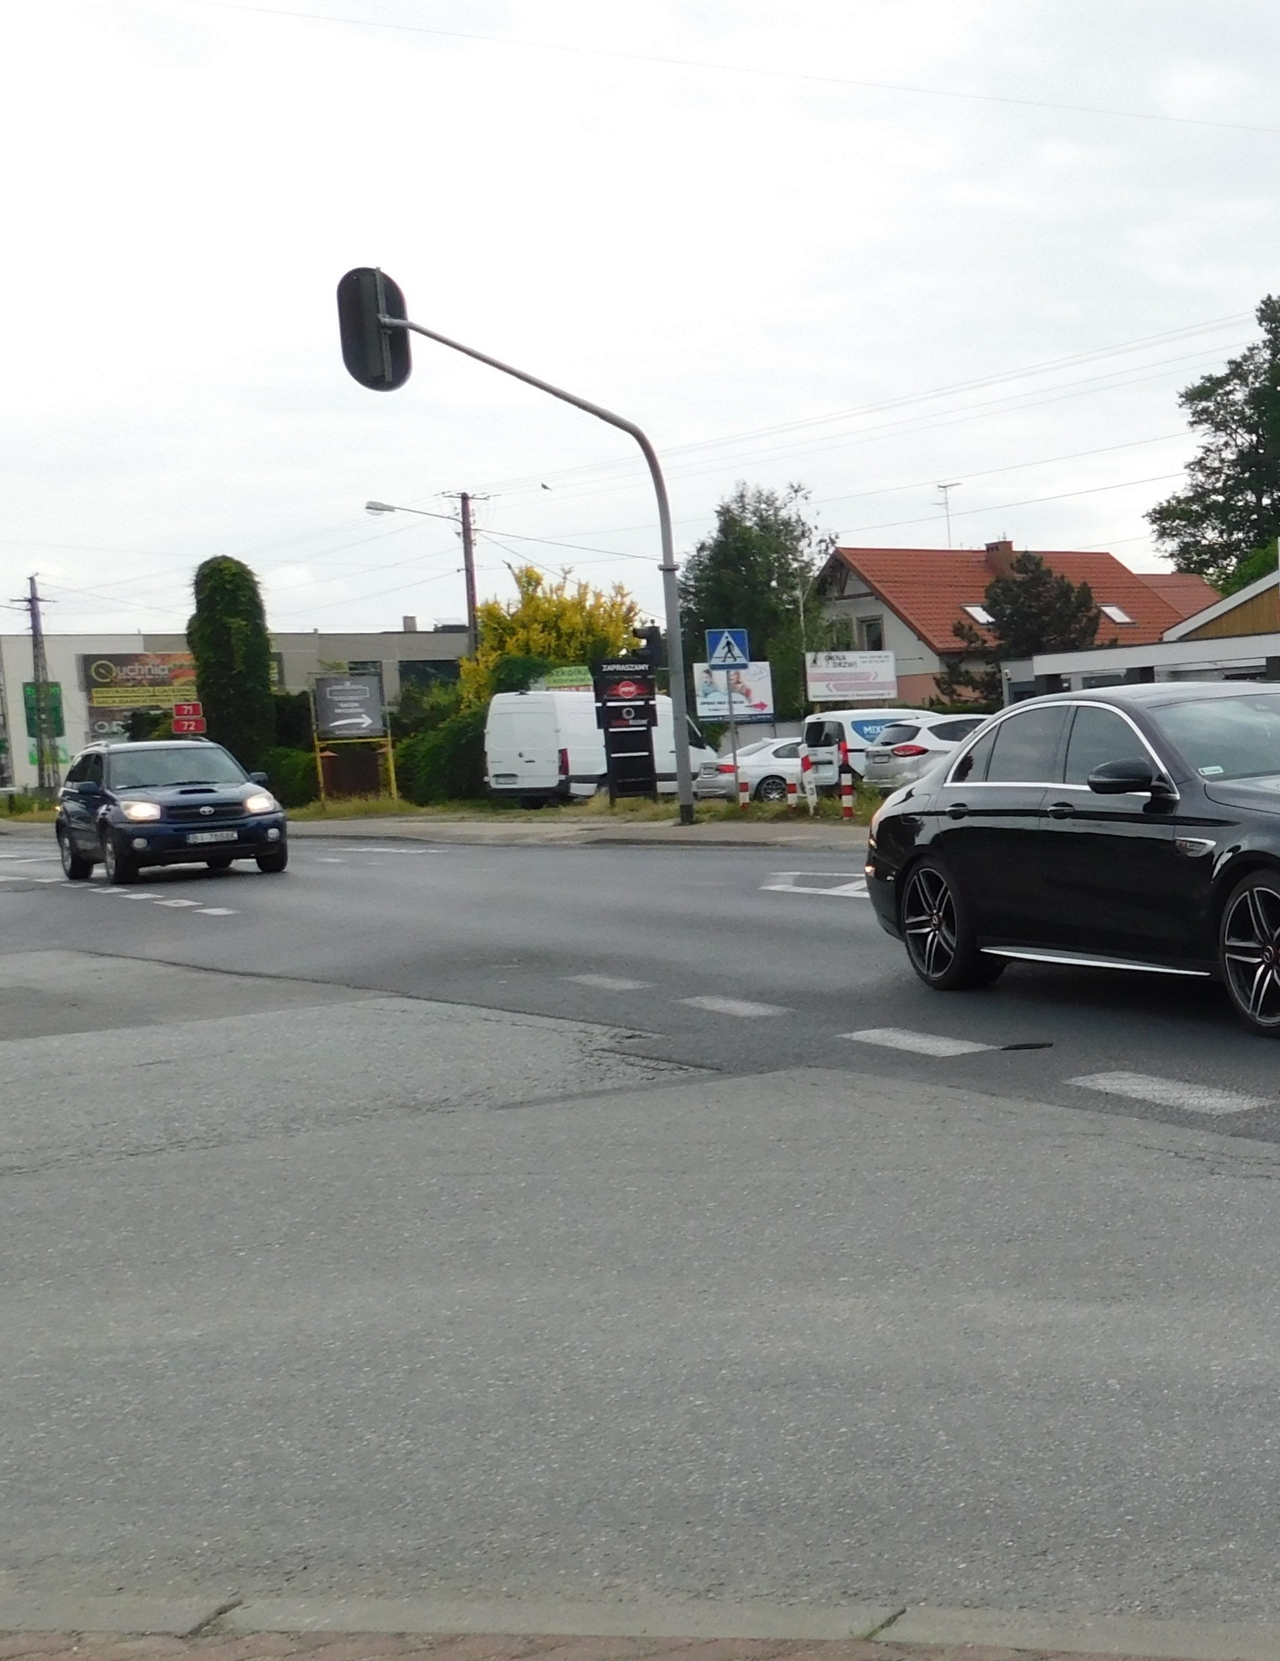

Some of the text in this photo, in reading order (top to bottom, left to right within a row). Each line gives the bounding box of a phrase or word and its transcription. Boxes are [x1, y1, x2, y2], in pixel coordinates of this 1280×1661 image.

[602, 664, 651, 672] ZAPRASZAMY
[182, 705, 193, 715] 71
[181, 721, 196, 731] 72
